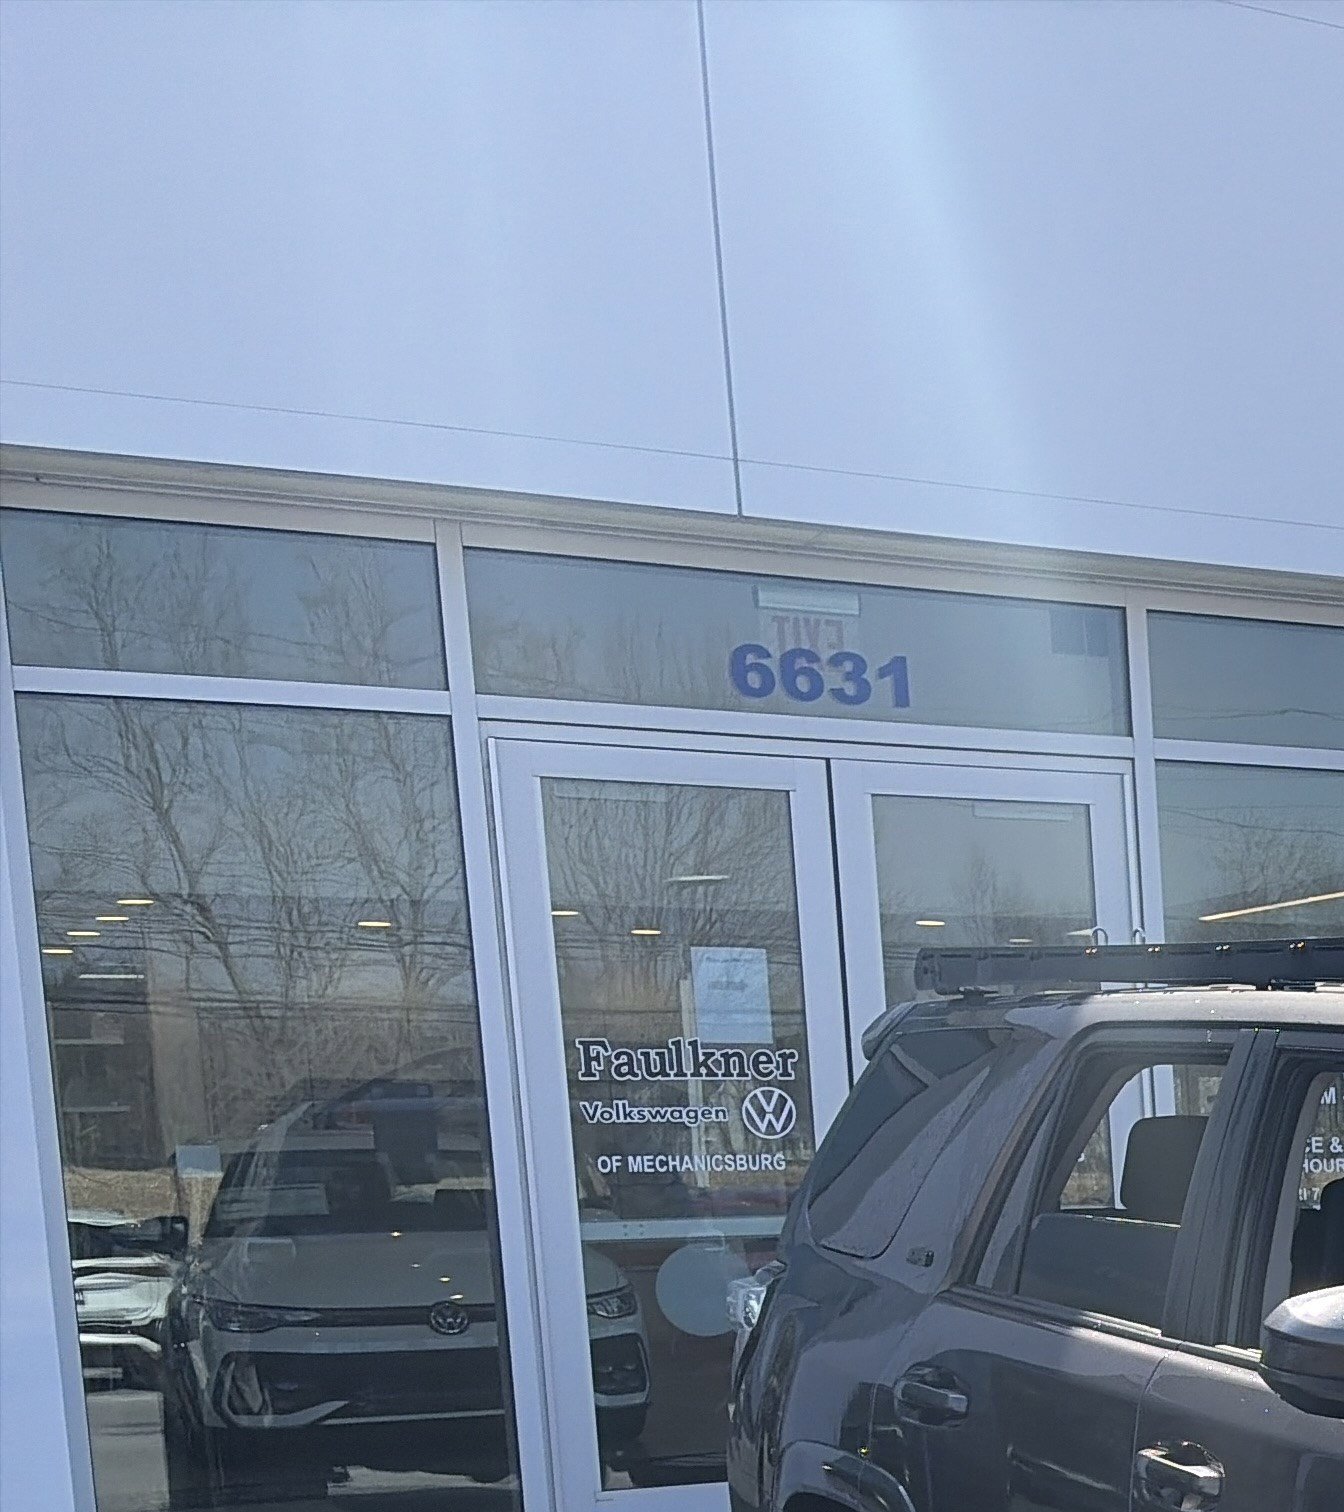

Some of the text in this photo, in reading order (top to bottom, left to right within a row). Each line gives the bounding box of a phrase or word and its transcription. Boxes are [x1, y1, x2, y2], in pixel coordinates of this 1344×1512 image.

[729, 643, 910, 709] 6631
[575, 1037, 798, 1080] Faulkner
[580, 1100, 729, 1126] Volkswagen
[1330, 1136, 1344, 1154] &
[597, 1153, 787, 1174] OF MECHANICSBURG
